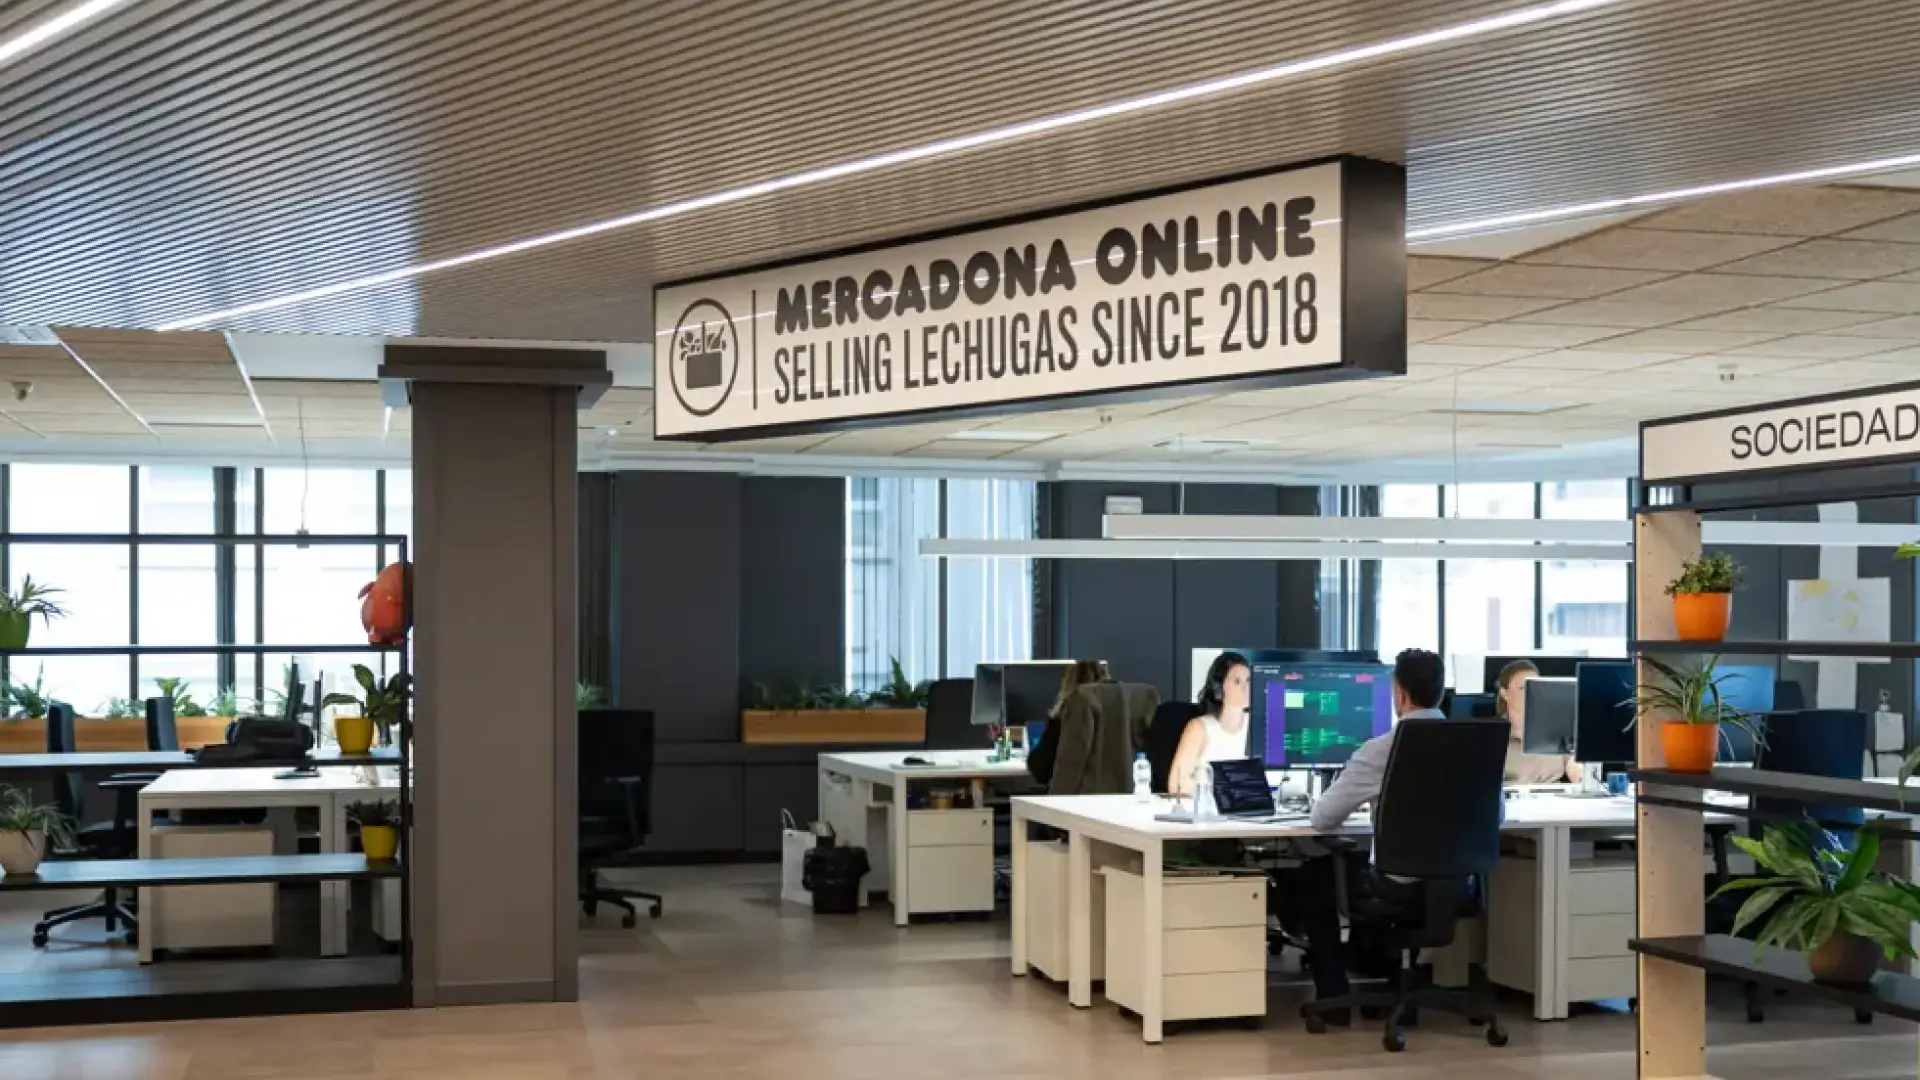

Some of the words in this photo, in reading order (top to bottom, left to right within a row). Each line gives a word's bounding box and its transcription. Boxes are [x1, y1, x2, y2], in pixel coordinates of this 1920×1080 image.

[774, 238, 1077, 336] MERCADONA
[1095, 195, 1316, 285] ONLINE
[774, 332, 892, 404] SELLING
[903, 305, 1078, 389] LECHUGAS
[1091, 287, 1205, 367] SINCE
[1220, 272, 1318, 353] 2018
[1731, 403, 1920, 460] SOCIEDAD
